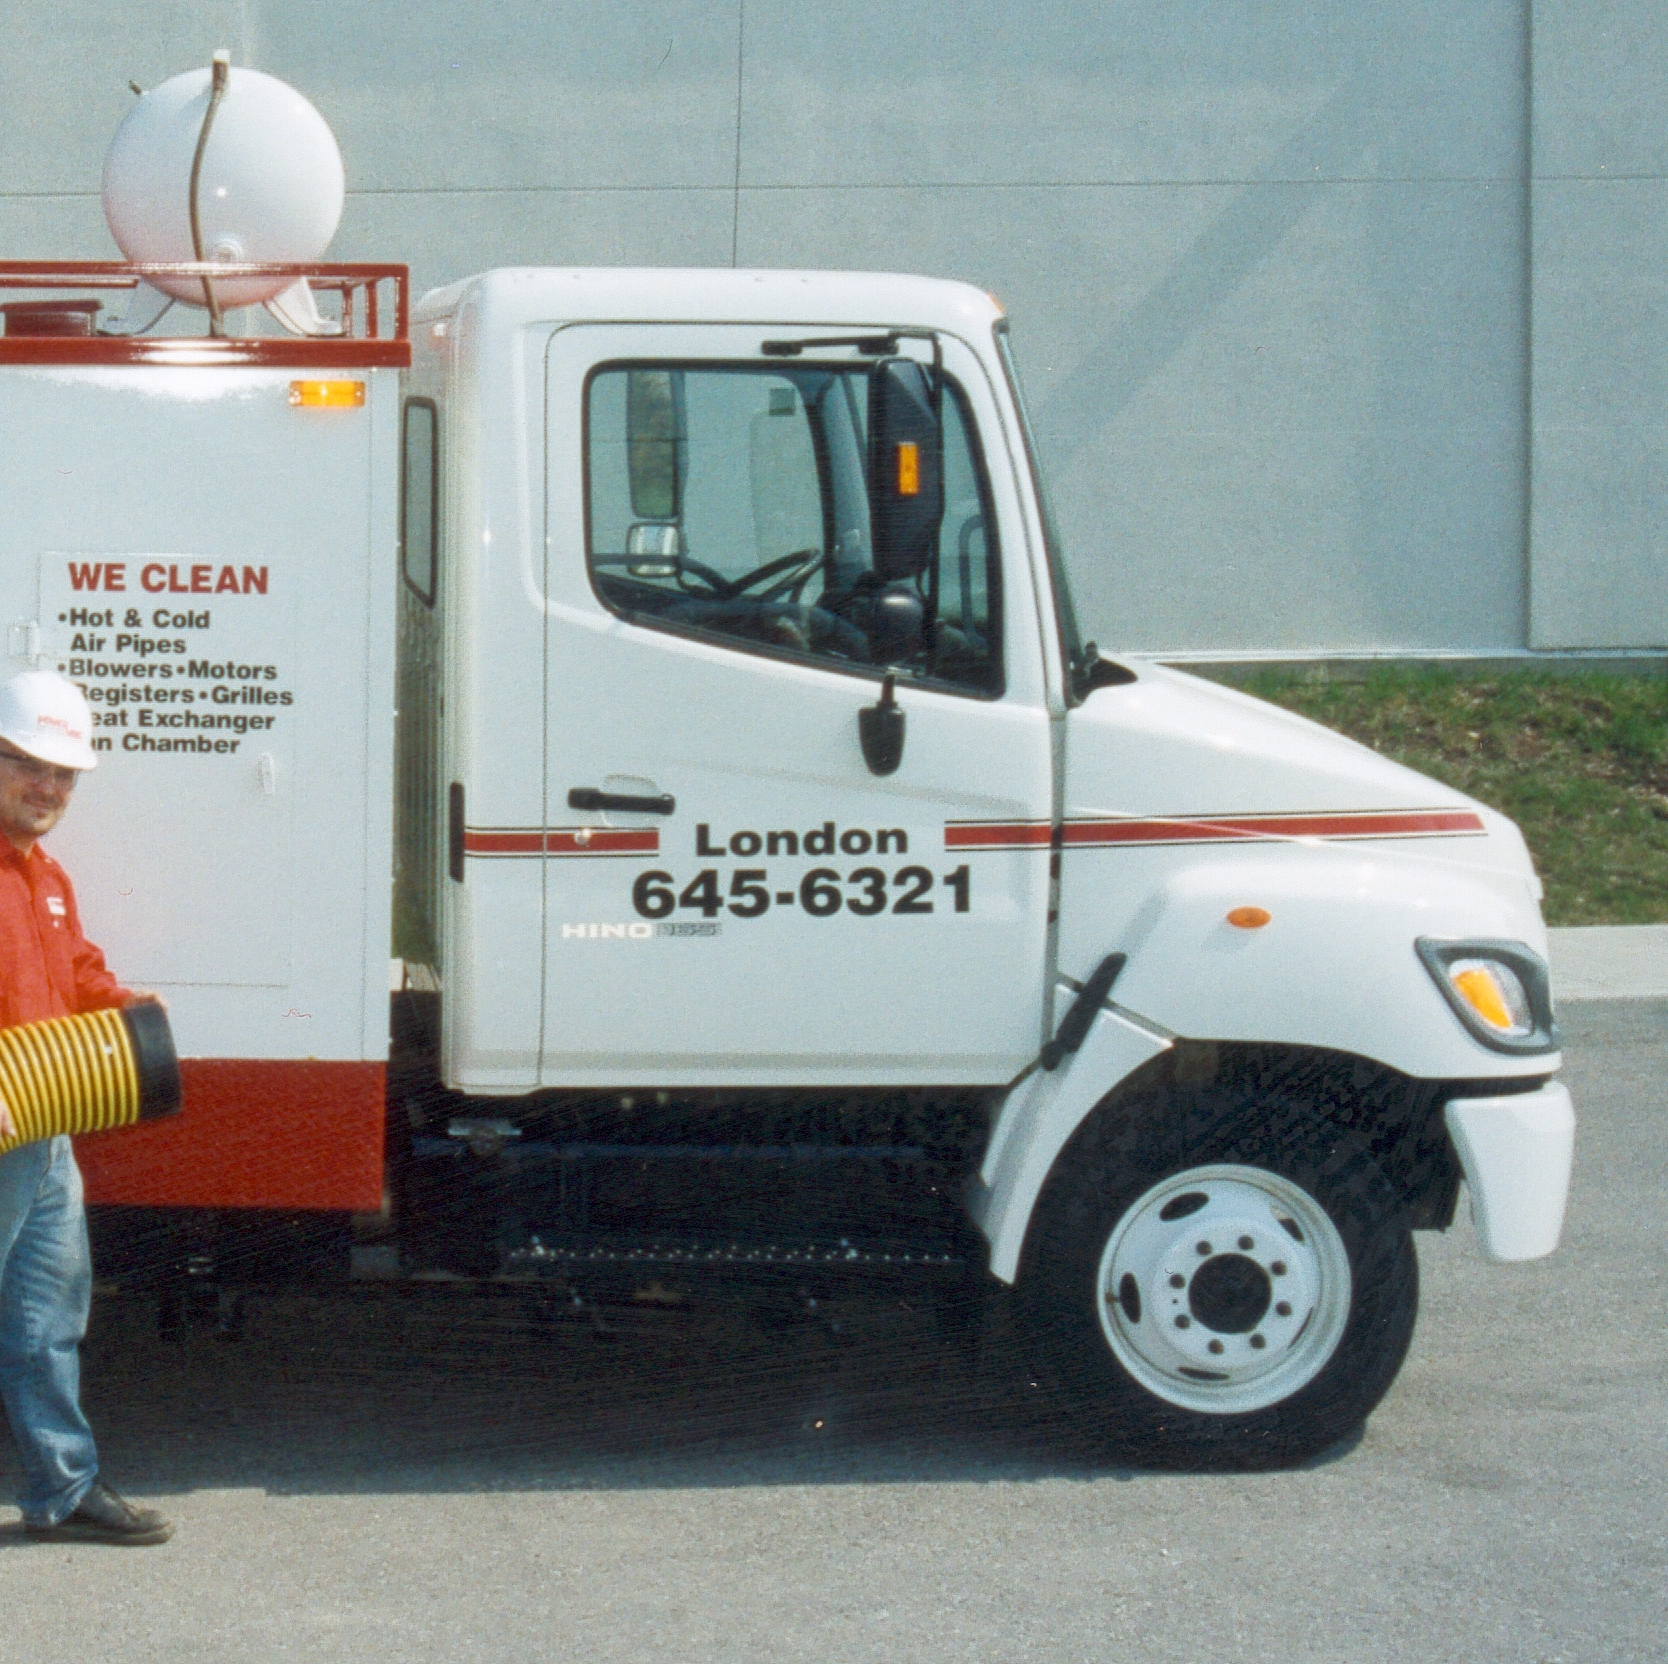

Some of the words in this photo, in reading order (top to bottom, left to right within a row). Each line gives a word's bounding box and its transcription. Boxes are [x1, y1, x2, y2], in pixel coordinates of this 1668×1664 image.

[67, 562, 126, 592] WE
[140, 563, 269, 595] CLEAN
[69, 607, 114, 628] Hot
[123, 608, 142, 628] &
[152, 608, 210, 630] Cold
[70, 632, 107, 652] Air
[115, 633, 187, 658] Pipes
[69, 658, 173, 679] Blowers
[188, 659, 278, 681] Motors
[211, 684, 294, 706] Grilles
[91, 708, 129, 728] eat
[138, 708, 276, 734] Exchanger
[121, 732, 241, 754] Chamber
[695, 820, 909, 858] London
[632, 864, 971, 920] 645-6321
[561, 922, 652, 939] HINO
